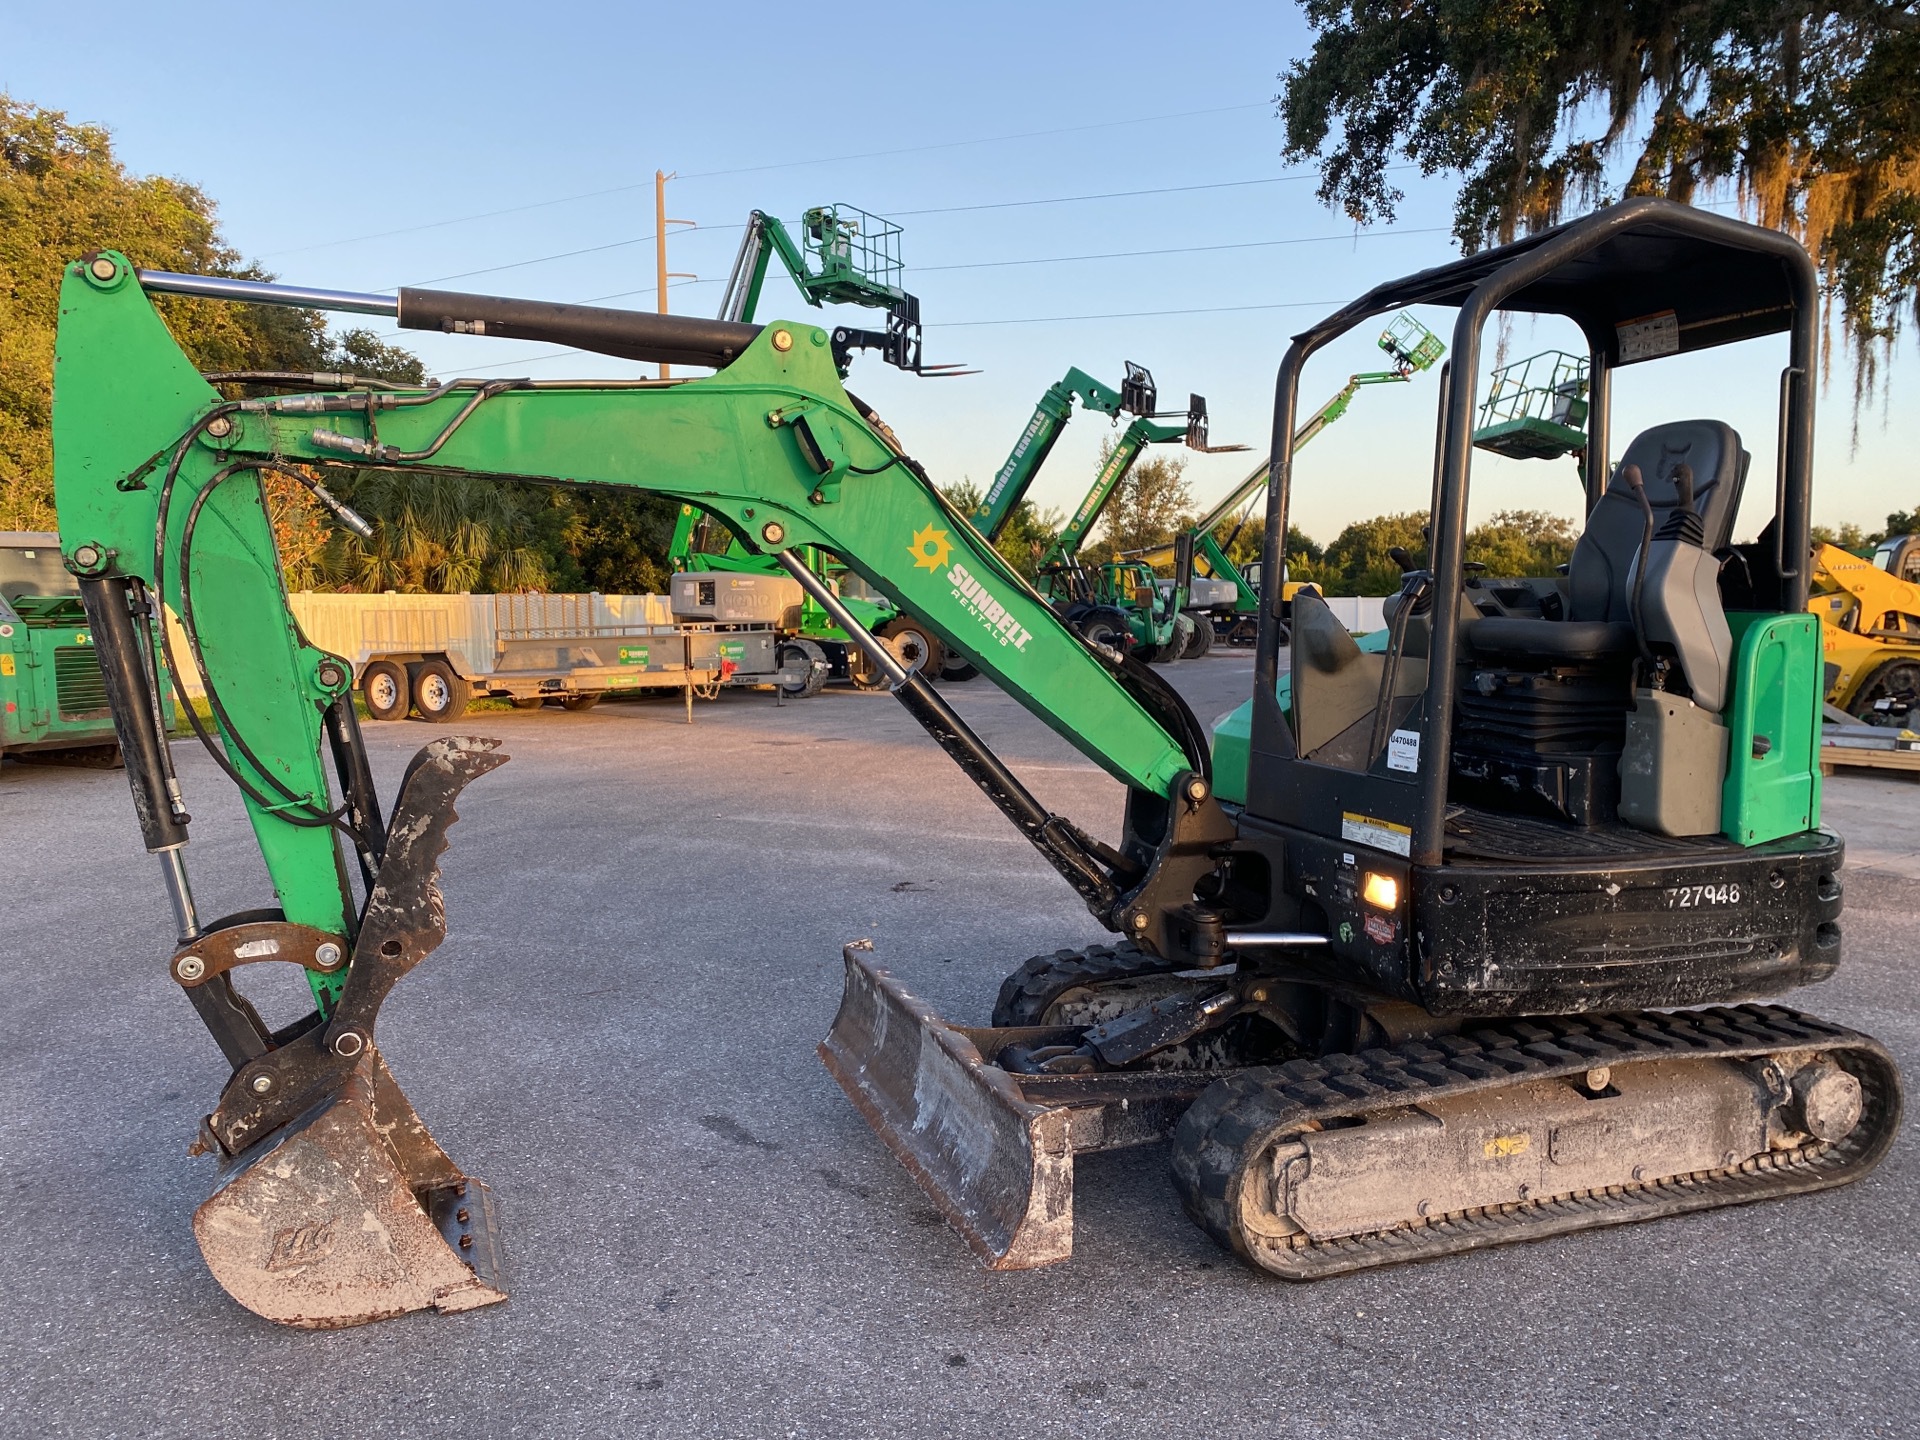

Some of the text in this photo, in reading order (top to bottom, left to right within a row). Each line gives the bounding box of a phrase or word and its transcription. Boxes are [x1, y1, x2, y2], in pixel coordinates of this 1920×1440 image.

[988, 410, 1046, 505] SUNBELT RENTALS
[946, 563, 1033, 649] SUNBELT
[951, 589, 1009, 647] RENTALS
[1666, 883, 1740, 909] 727948
